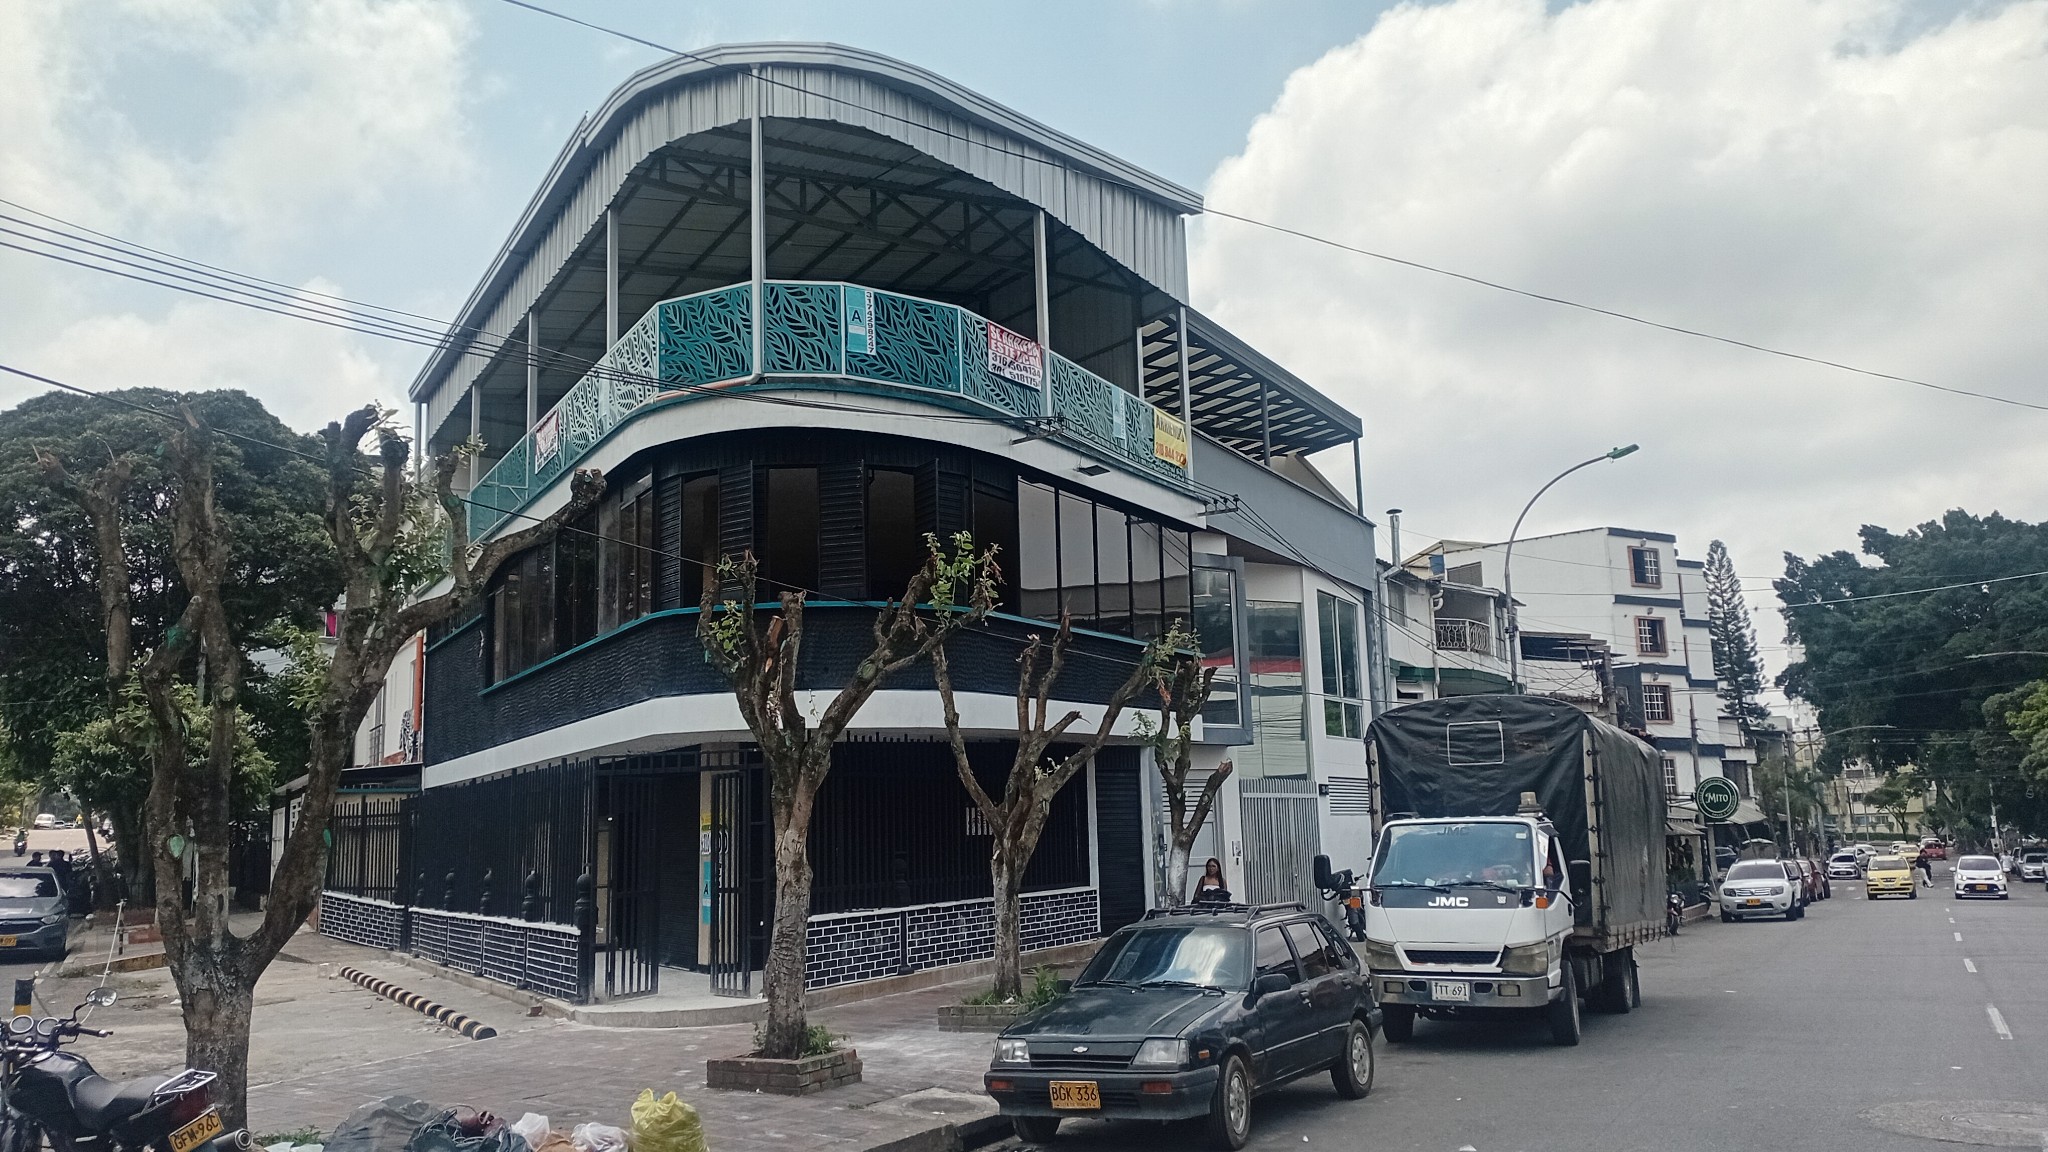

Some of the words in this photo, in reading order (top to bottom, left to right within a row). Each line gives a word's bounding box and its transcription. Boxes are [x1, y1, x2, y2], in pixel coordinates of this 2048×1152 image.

[851, 309, 862, 323] A
[991, 340, 1015, 360] ESTE
[1437, 827, 1469, 835] JMC
[1428, 897, 1469, 907] JMC
[1452, 984, 1467, 997] 691
[1051, 1085, 1073, 1101] BGK
[1075, 1085, 1097, 1101] 336
